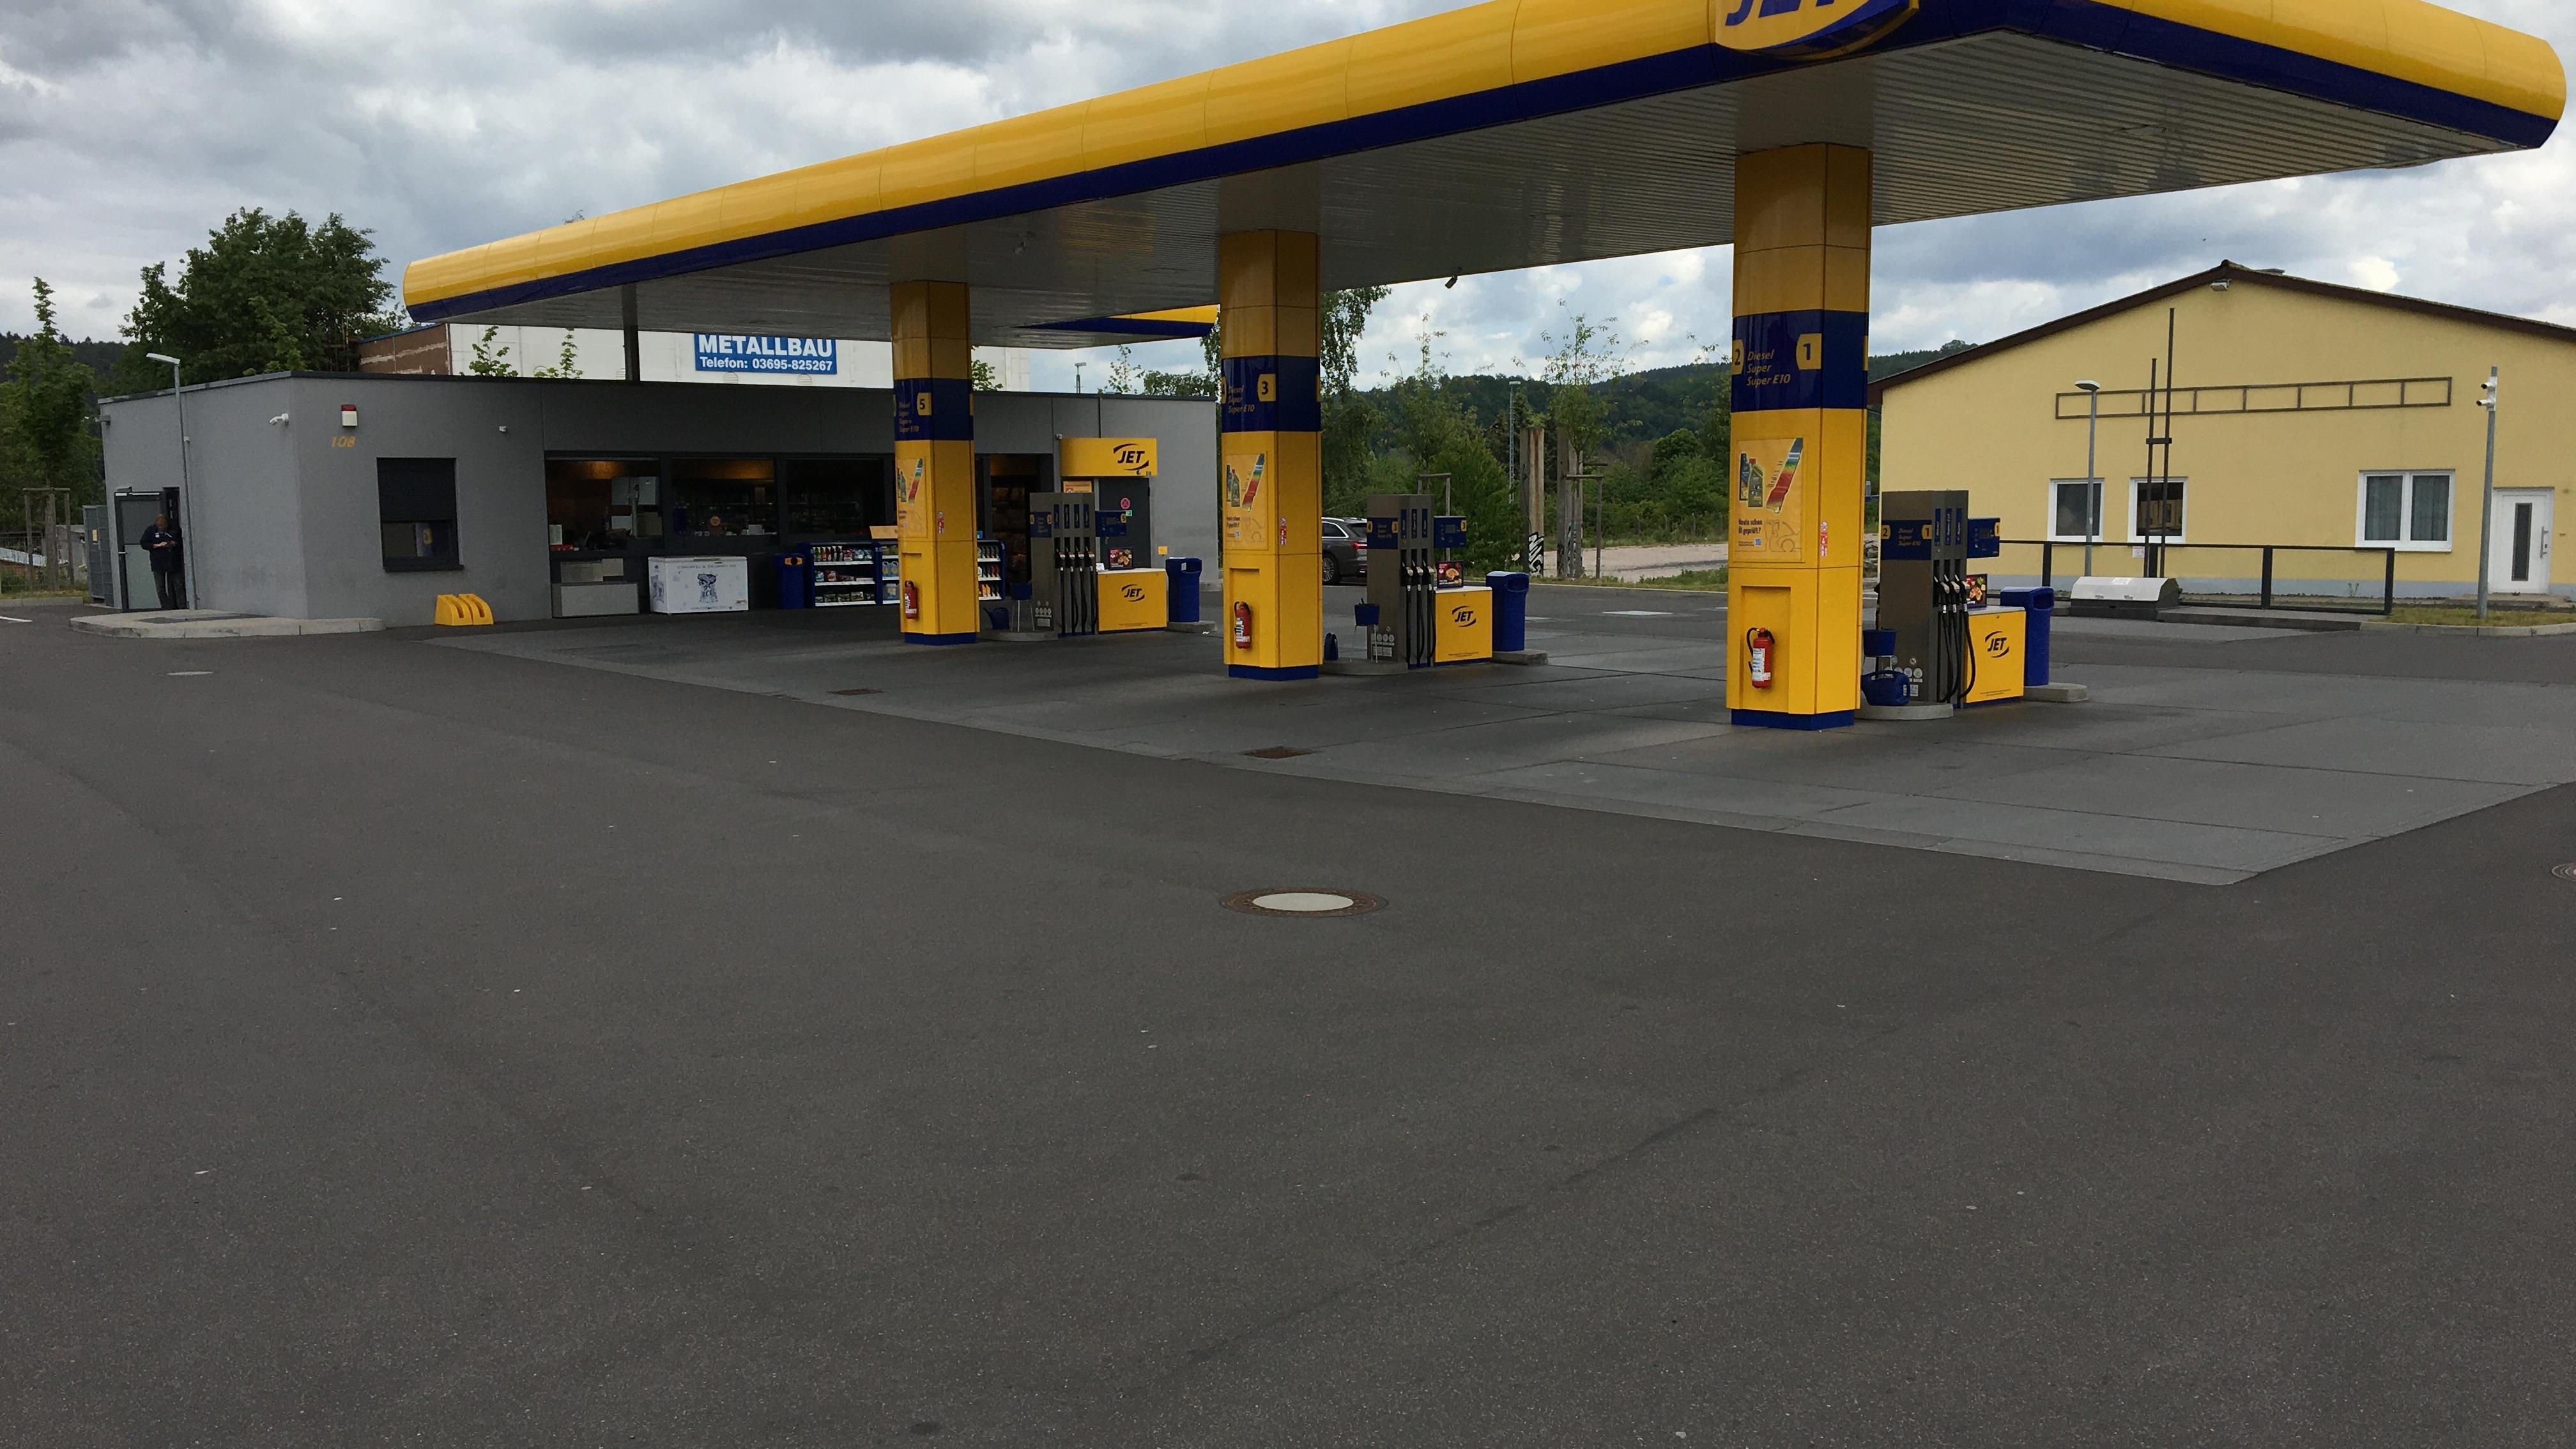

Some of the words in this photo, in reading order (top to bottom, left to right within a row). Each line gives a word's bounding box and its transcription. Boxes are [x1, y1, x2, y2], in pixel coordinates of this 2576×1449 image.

[698, 334, 832, 357] METALLBAU
[1803, 343, 1811, 360] 1
[1735, 348, 1741, 365] 2
[1747, 348, 1775, 361] Diesel
[700, 356, 748, 369] Telefon:
[752, 358, 832, 371] 03695-825267
[1747, 364, 1772, 376] Super
[1746, 376, 1772, 388] Super
[1772, 373, 1791, 384] E10
[1261, 381, 1269, 395] 3
[919, 399, 925, 410] 5
[1117, 450, 1145, 464] JET
[1882, 528, 1889, 537] 2
[1925, 528, 1930, 537] 1
[1124, 588, 1142, 599] JET
[1454, 611, 1473, 622] JET
[1987, 637, 2007, 652] JET
